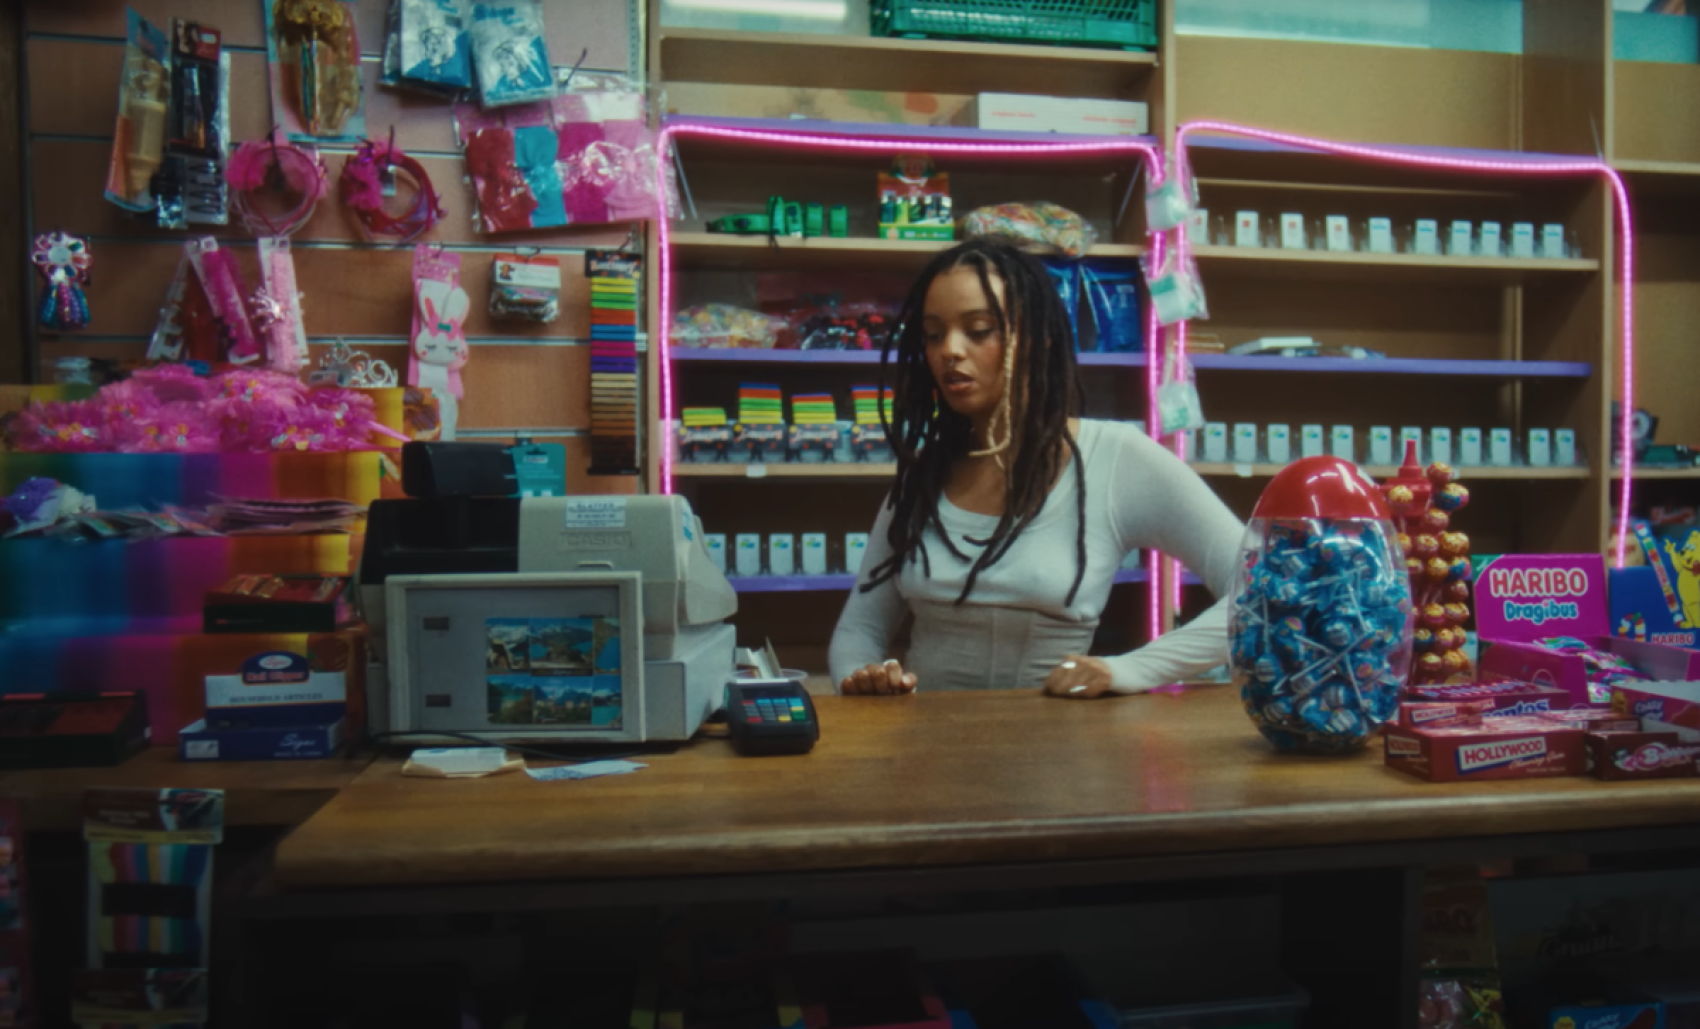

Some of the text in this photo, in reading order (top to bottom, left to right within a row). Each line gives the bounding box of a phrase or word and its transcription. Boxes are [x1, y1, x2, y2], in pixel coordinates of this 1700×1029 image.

[567, 533, 626, 546] CASIO
[1490, 569, 1587, 596] HARIBO
[1504, 599, 1578, 624] Dragibus
[1652, 634, 1694, 645] HARIBO
[230, 693, 323, 703] HOUSEHOLD ARTICLES
[1413, 708, 1455, 720] HOLLYWOOD
[1464, 740, 1542, 765] HOLLYWOOD
